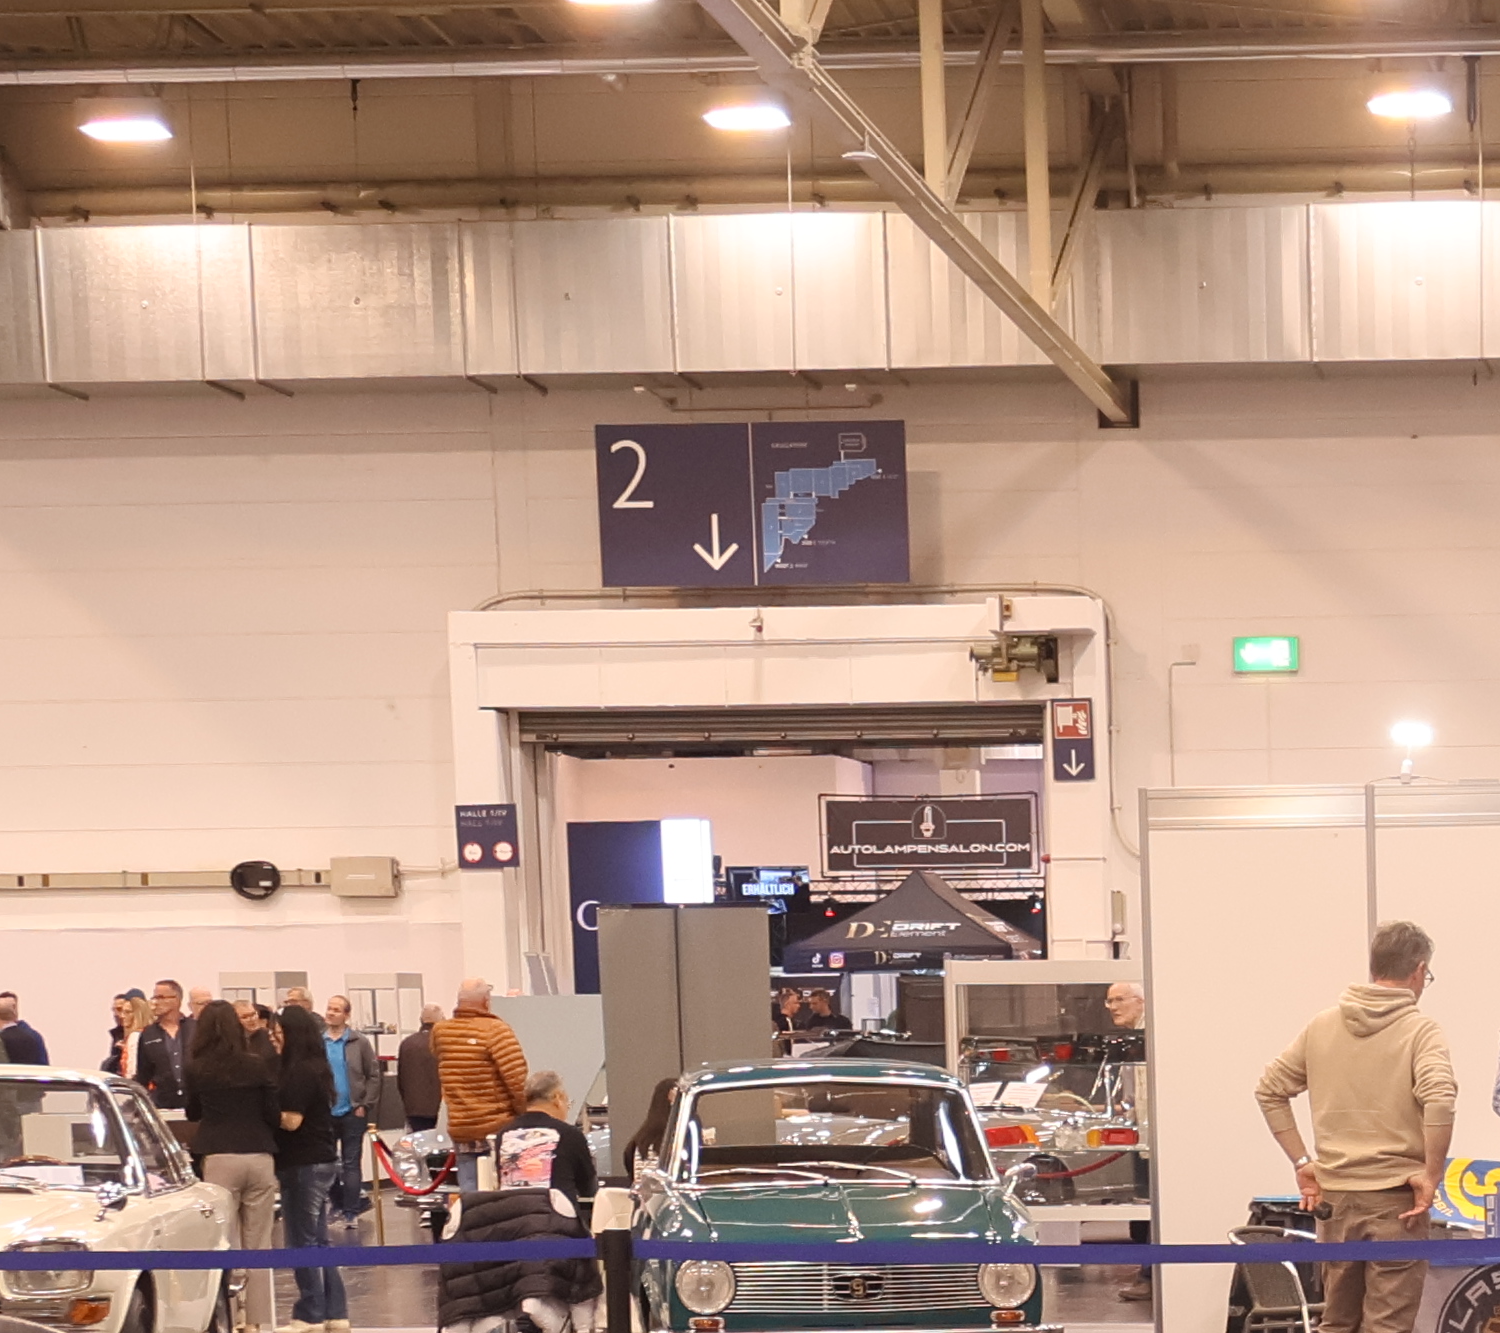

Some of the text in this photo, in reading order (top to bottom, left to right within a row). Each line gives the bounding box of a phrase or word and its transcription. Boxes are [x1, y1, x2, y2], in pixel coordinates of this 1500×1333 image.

[610, 440, 654, 509] 2
[830, 842, 1030, 855] AUTOLAMPENSALON.COM
[742, 881, 795, 895] ERHÄLTLICH
[891, 922, 961, 931] DRIFT
